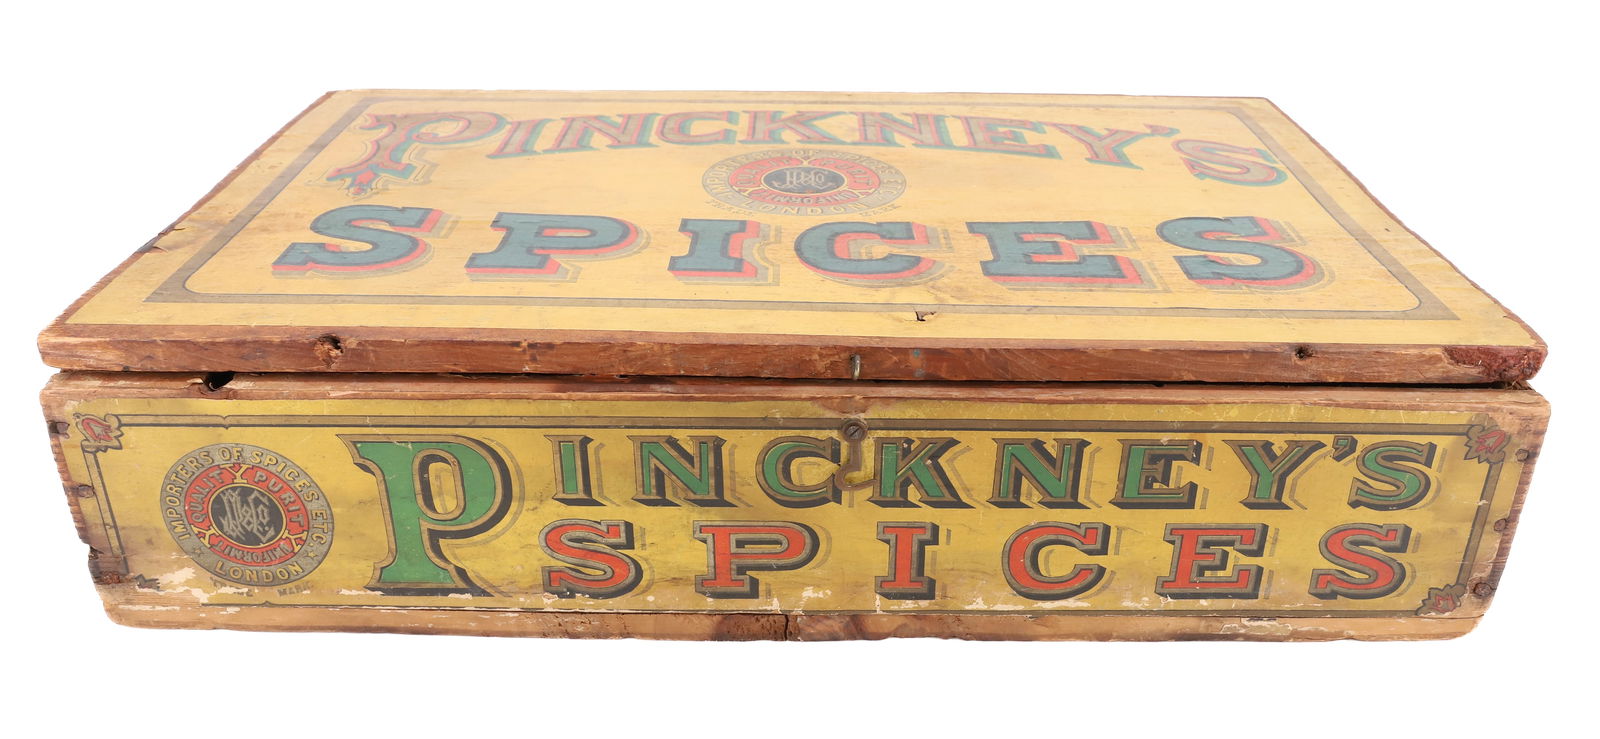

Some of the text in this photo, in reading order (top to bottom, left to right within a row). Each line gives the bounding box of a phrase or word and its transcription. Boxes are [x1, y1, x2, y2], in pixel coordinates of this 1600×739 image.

[326, 110, 1287, 199] PINCKNEY'S
[272, 204, 1324, 290] SPICES
[741, 199, 867, 216] LONDON
[165, 450, 215, 541] IMPORTERS
[218, 447, 244, 462] OF
[249, 450, 320, 503] SPICES
[335, 433, 1438, 598] PINCKNEY'S
[214, 560, 304, 583] LONDON
[538, 519, 1412, 600] SPICES
